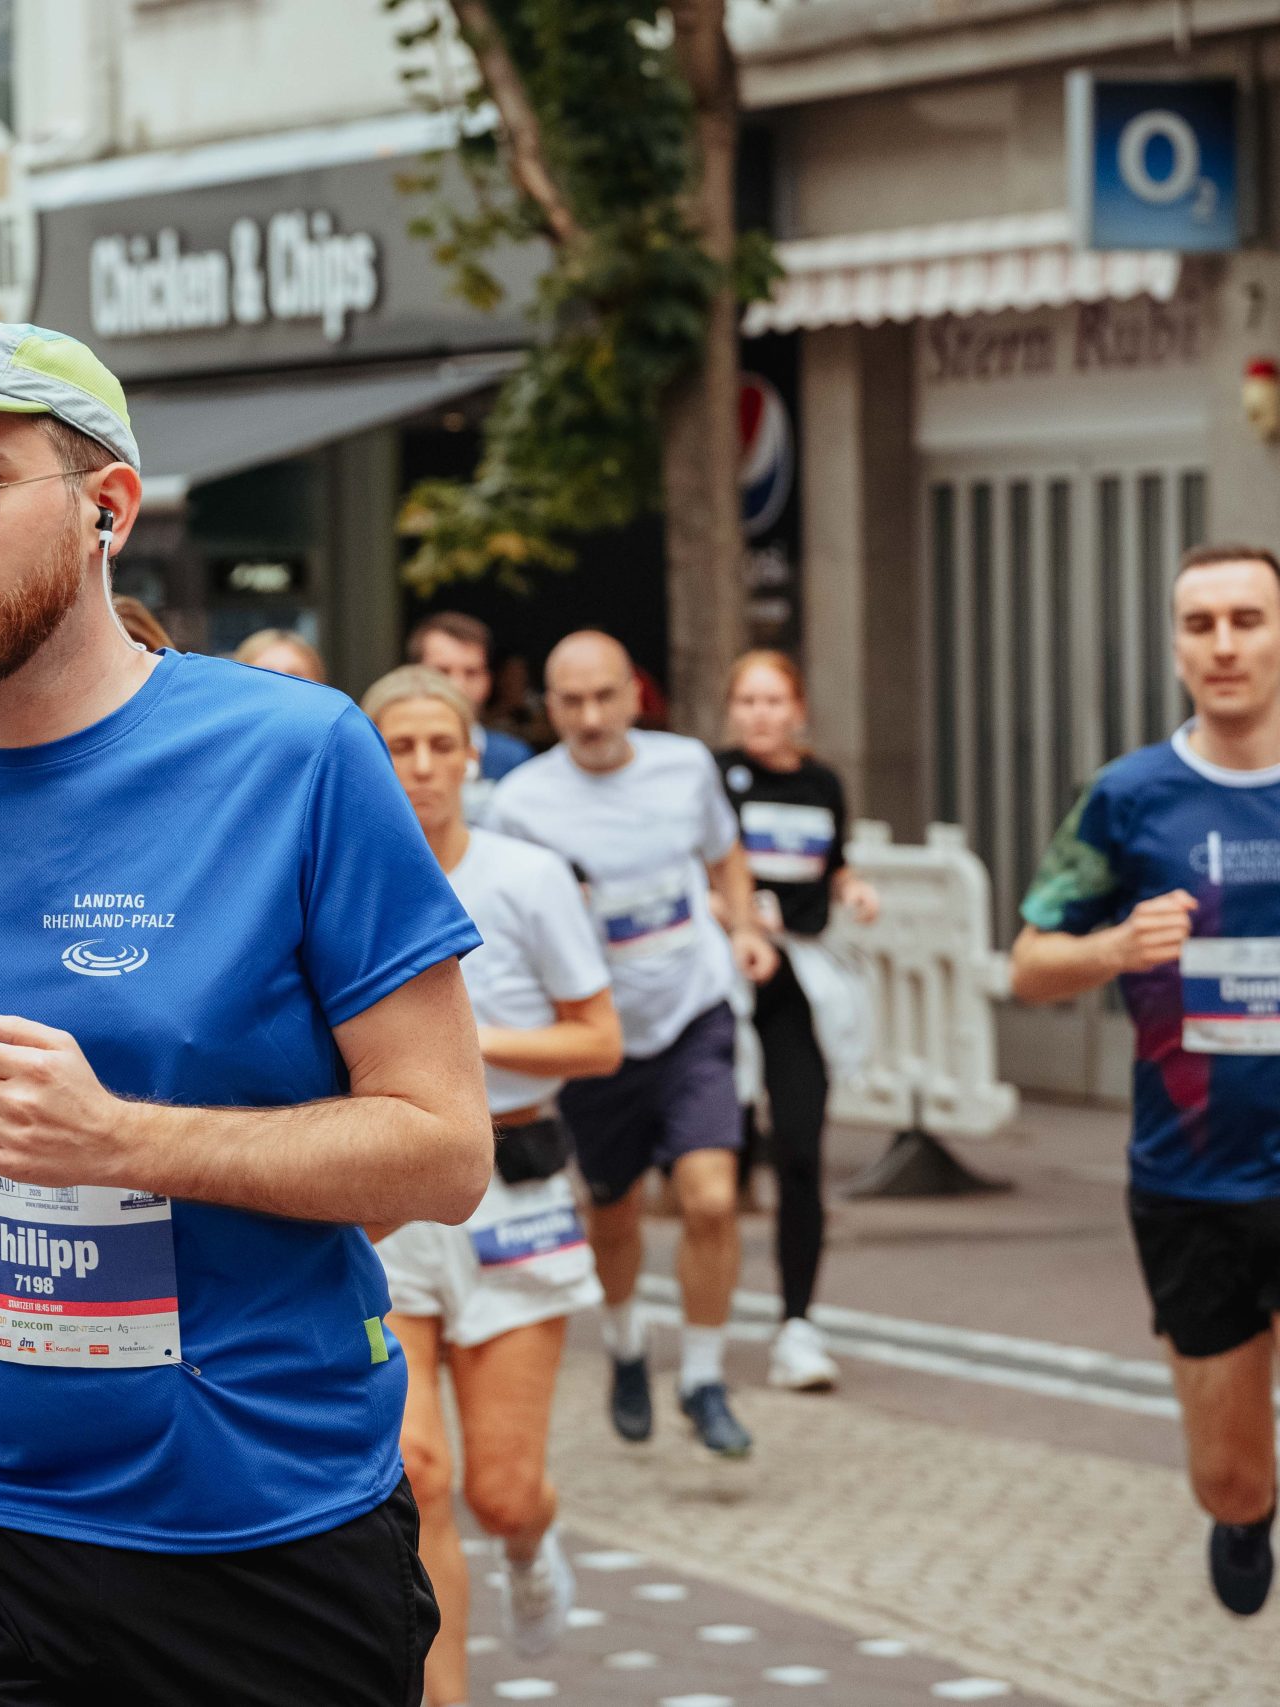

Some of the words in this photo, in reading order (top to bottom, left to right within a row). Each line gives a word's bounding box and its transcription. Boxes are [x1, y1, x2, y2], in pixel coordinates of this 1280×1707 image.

[91, 227, 228, 337] Chicken
[230, 217, 266, 325] &
[268, 209, 378, 342] Chips
[74, 893, 145, 908] LANDTAG
[43, 913, 175, 929] RHEINLAND-PFALZ
[15, 1273, 54, 1295] 7198
[8, 1299, 34, 1311] STARTZEIT
[35, 1301, 50, 1312] 18:45
[50, 1304, 63, 1313] UHR
